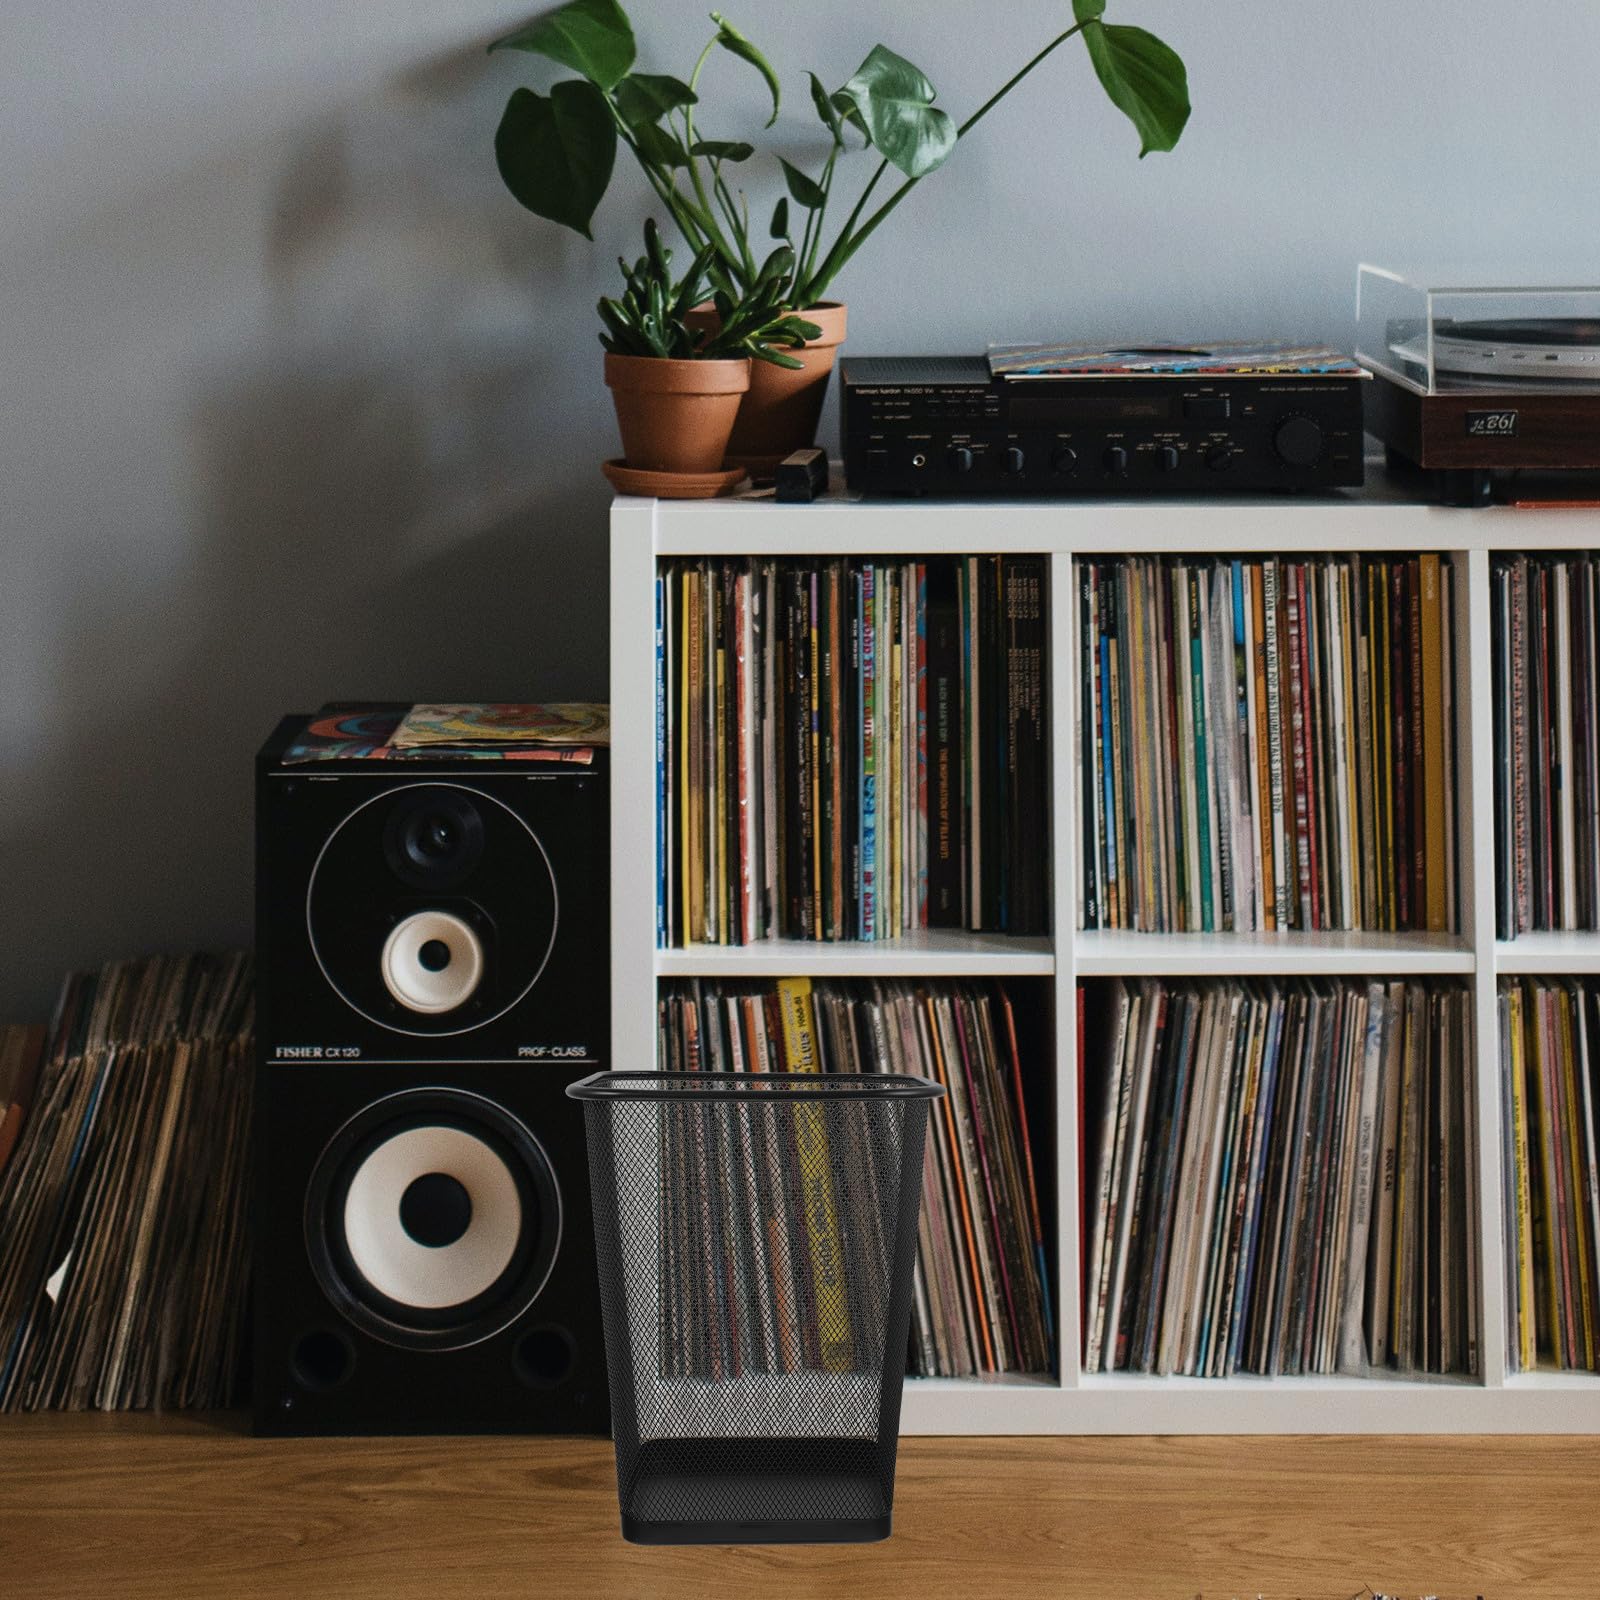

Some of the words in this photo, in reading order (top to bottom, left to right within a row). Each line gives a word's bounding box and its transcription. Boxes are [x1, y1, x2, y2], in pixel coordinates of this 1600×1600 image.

[1264, 569, 1275, 611] PAKISTAN
[863, 570, 873, 654] BOLLYWOOD
[1266, 625, 1277, 648] FOLK
[1266, 648, 1277, 668] AND
[863, 659, 873, 703] STEEL
[938, 677, 948, 702] BLACK
[1267, 671, 1278, 690] POP
[938, 702, 948, 727] MAN'S
[863, 705, 873, 758] GUITAR
[1268, 691, 1281, 764] INSTRUMENTALS
[939, 748, 949, 763] THE
[939, 764, 949, 810] INSPIRATION
[939, 821, 949, 838] FELA
[275, 1046, 322, 1058] FISHER
[325, 1047, 340, 1058] CX
[341, 1047, 361, 1058] 120
[517, 1046, 588, 1057] PROF-CLASS
